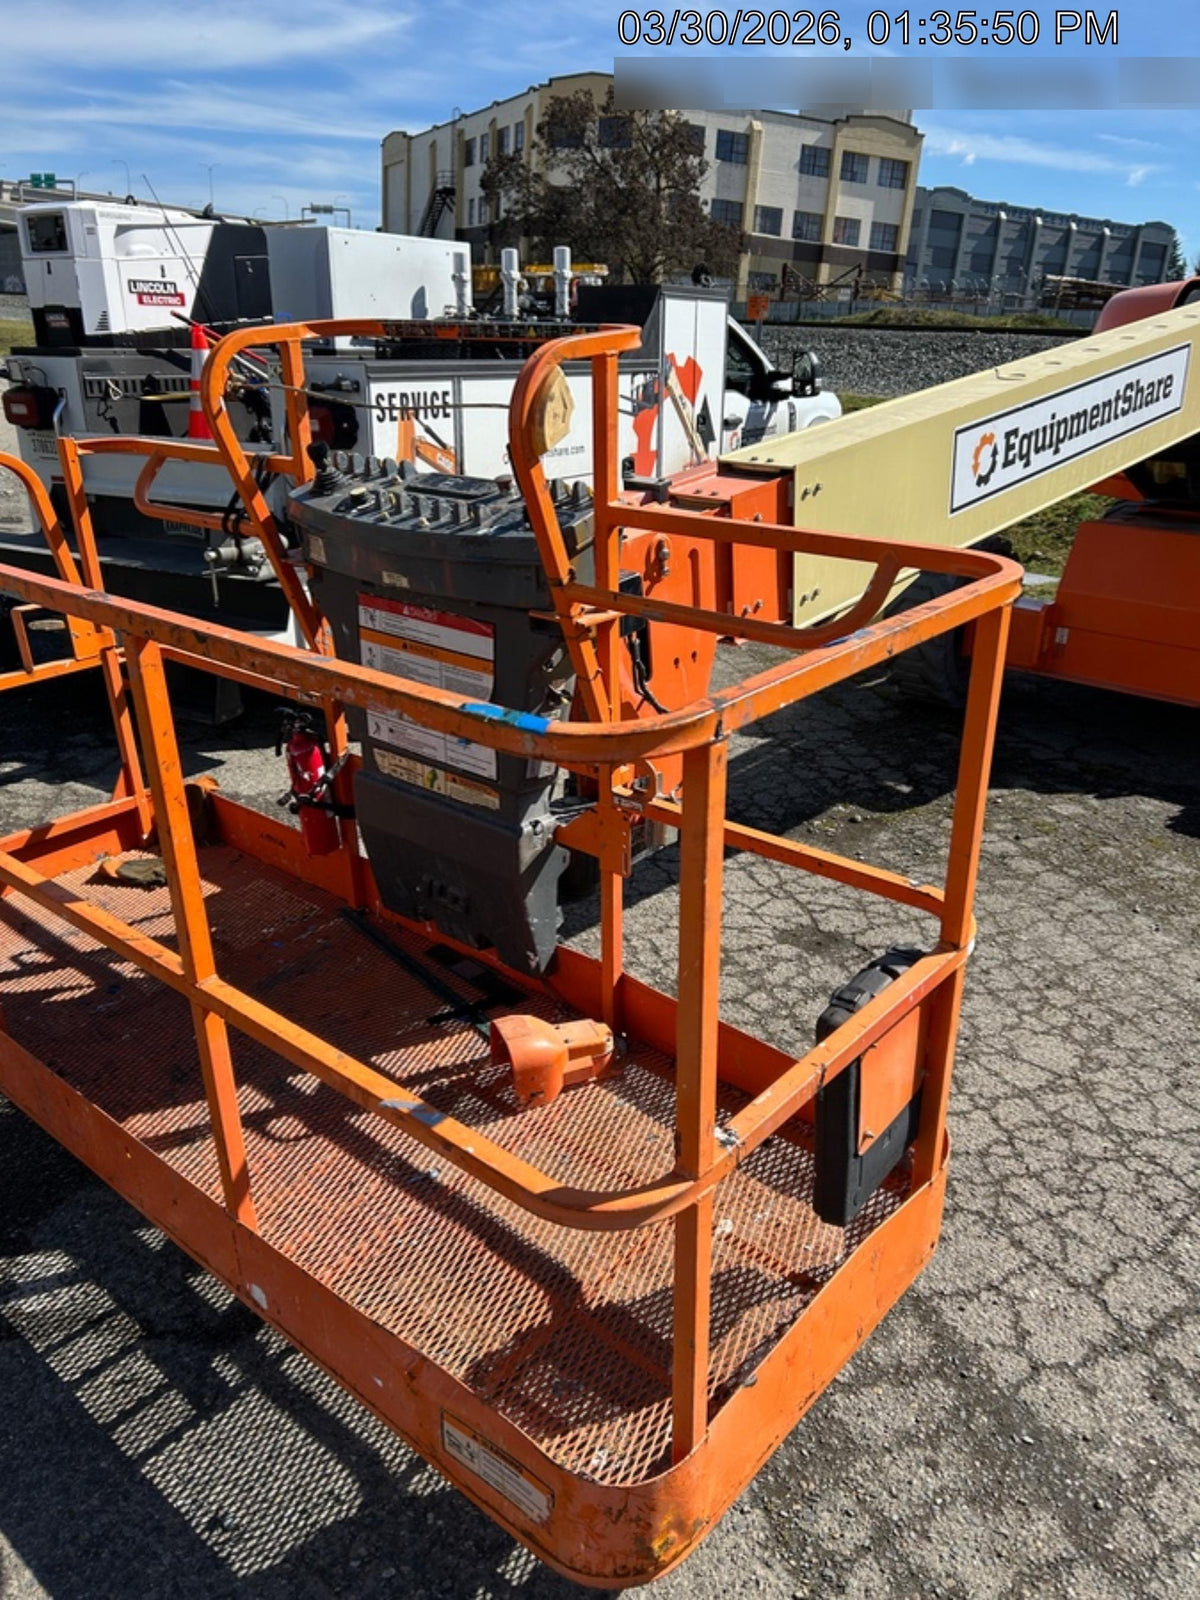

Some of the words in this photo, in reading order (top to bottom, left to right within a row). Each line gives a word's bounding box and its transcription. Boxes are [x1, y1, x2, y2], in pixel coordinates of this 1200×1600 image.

[130, 281, 175, 295] LINCOLN
[142, 295, 182, 305] ELECTRIC
[375, 391, 451, 423] SERVICE
[1001, 374, 1174, 468] EquipmentShare
